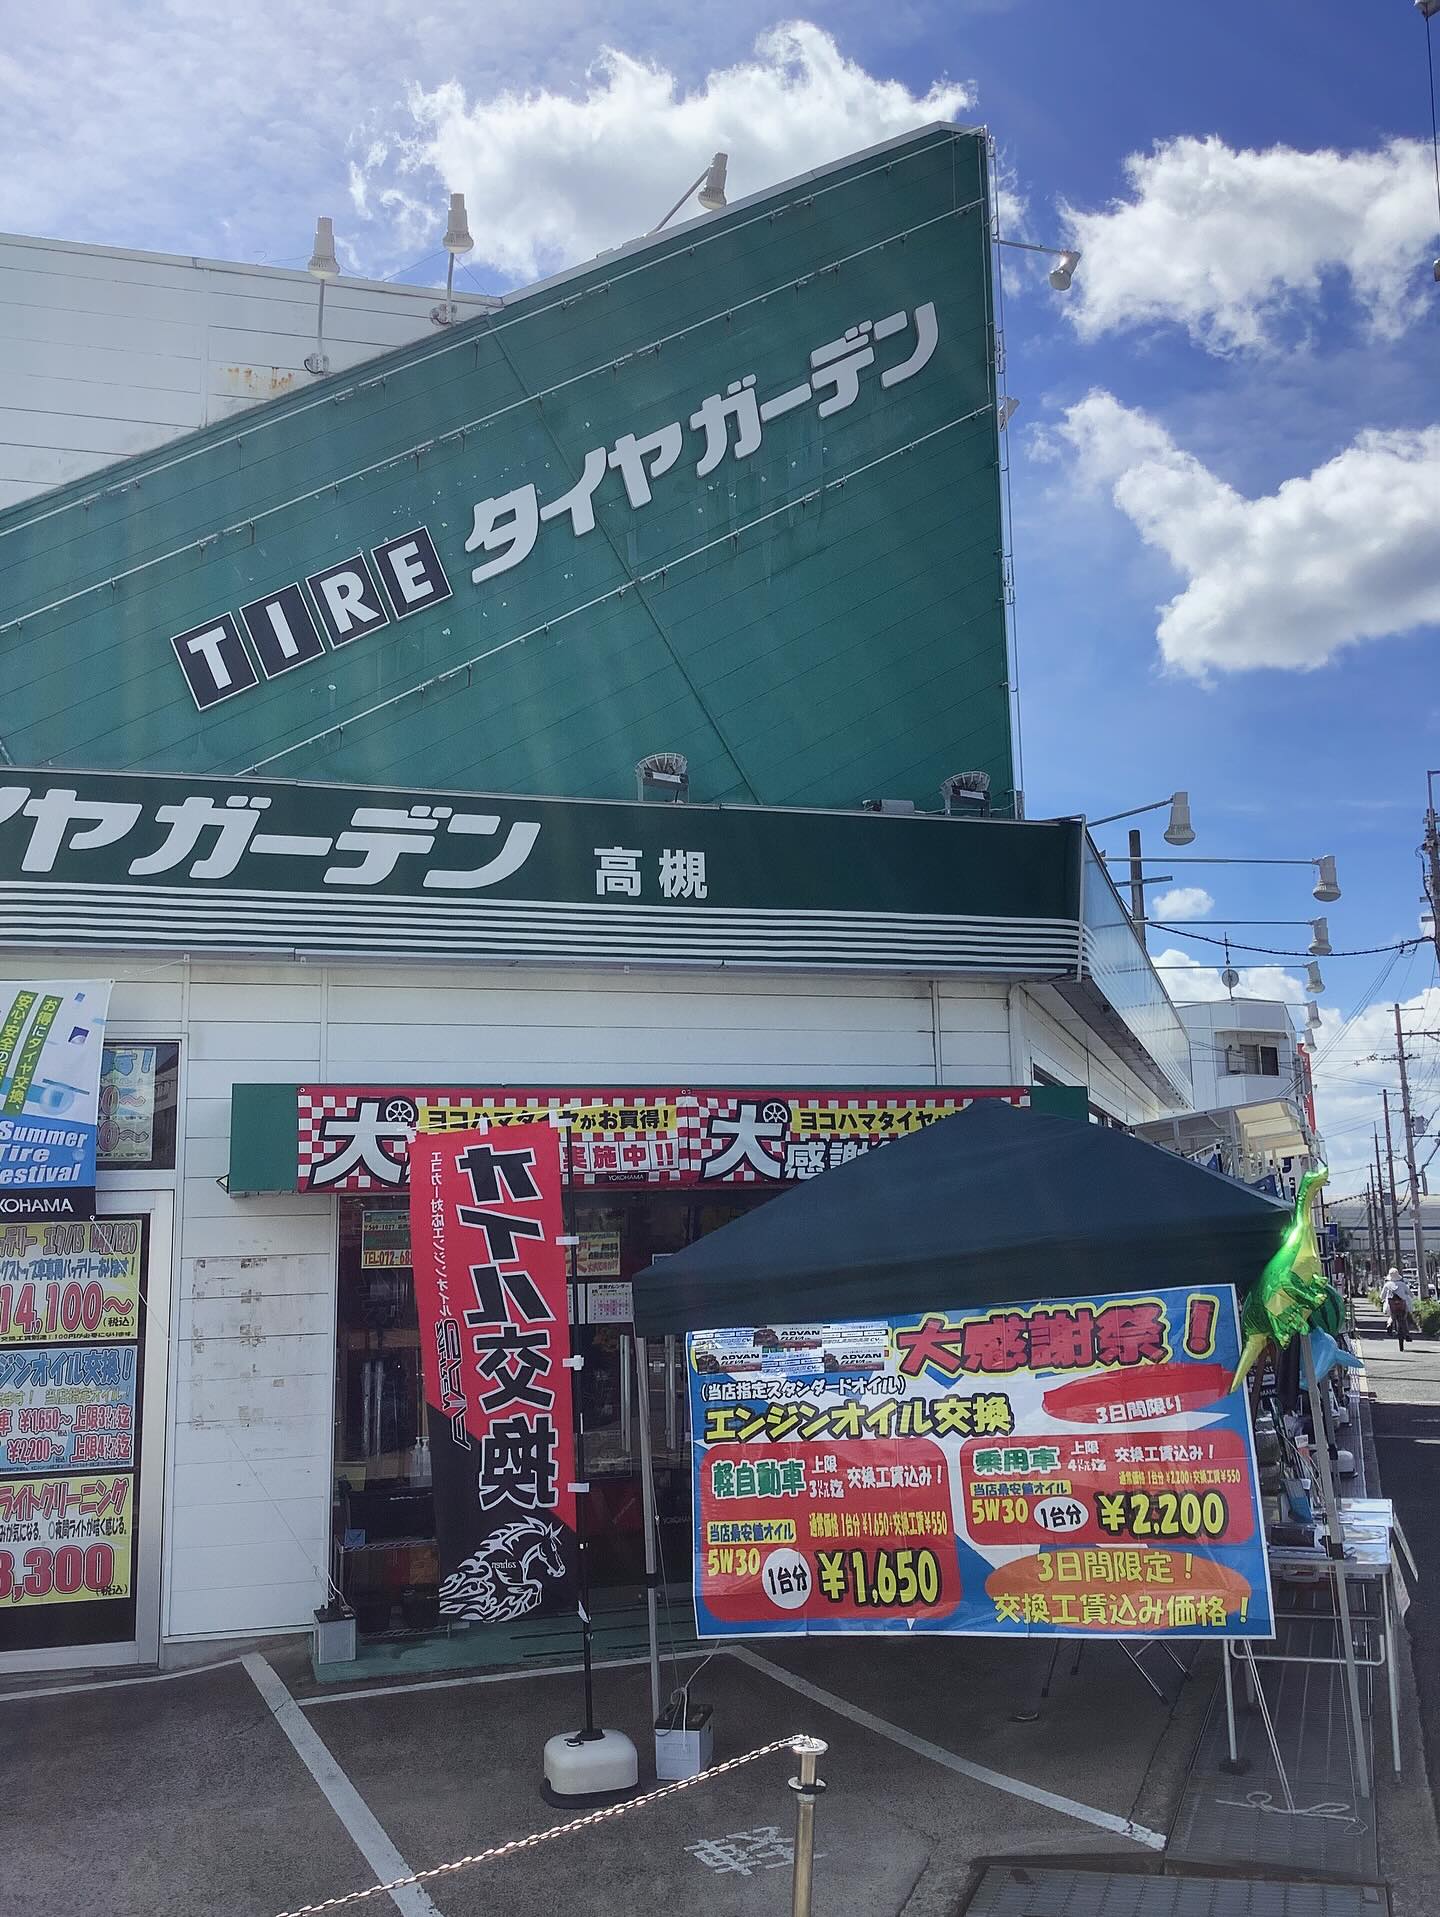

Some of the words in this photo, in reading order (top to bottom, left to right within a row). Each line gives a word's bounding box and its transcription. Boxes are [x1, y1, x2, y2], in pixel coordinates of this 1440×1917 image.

[464, 301, 941, 585] タイヤガーデン
[186, 540, 438, 691] TIRE
[0, 786, 541, 889] ヤガーデン
[593, 846, 709, 899] 高槻
[0, 1120, 89, 1148] Summer
[427, 1108, 670, 1130] ヨコハマタヤがお買得!
[799, 1110, 945, 1132] ヨコハマタイヤ
[840, 1352, 882, 1360] ADVAN
[705, 1392, 1014, 1442] エンジンオイル交換
[711, 1457, 807, 1500] 軽自動車
[972, 1446, 1061, 1476] 乗用車
[971, 1498, 1029, 1525] 5W30
[1040, 1505, 1082, 1529] 1台分
[1097, 1493, 1226, 1535] ¥2,200
[707, 1548, 761, 1577] 5W30
[767, 1565, 809, 1594] 1台分
[818, 1549, 942, 1606] ¥1,650
